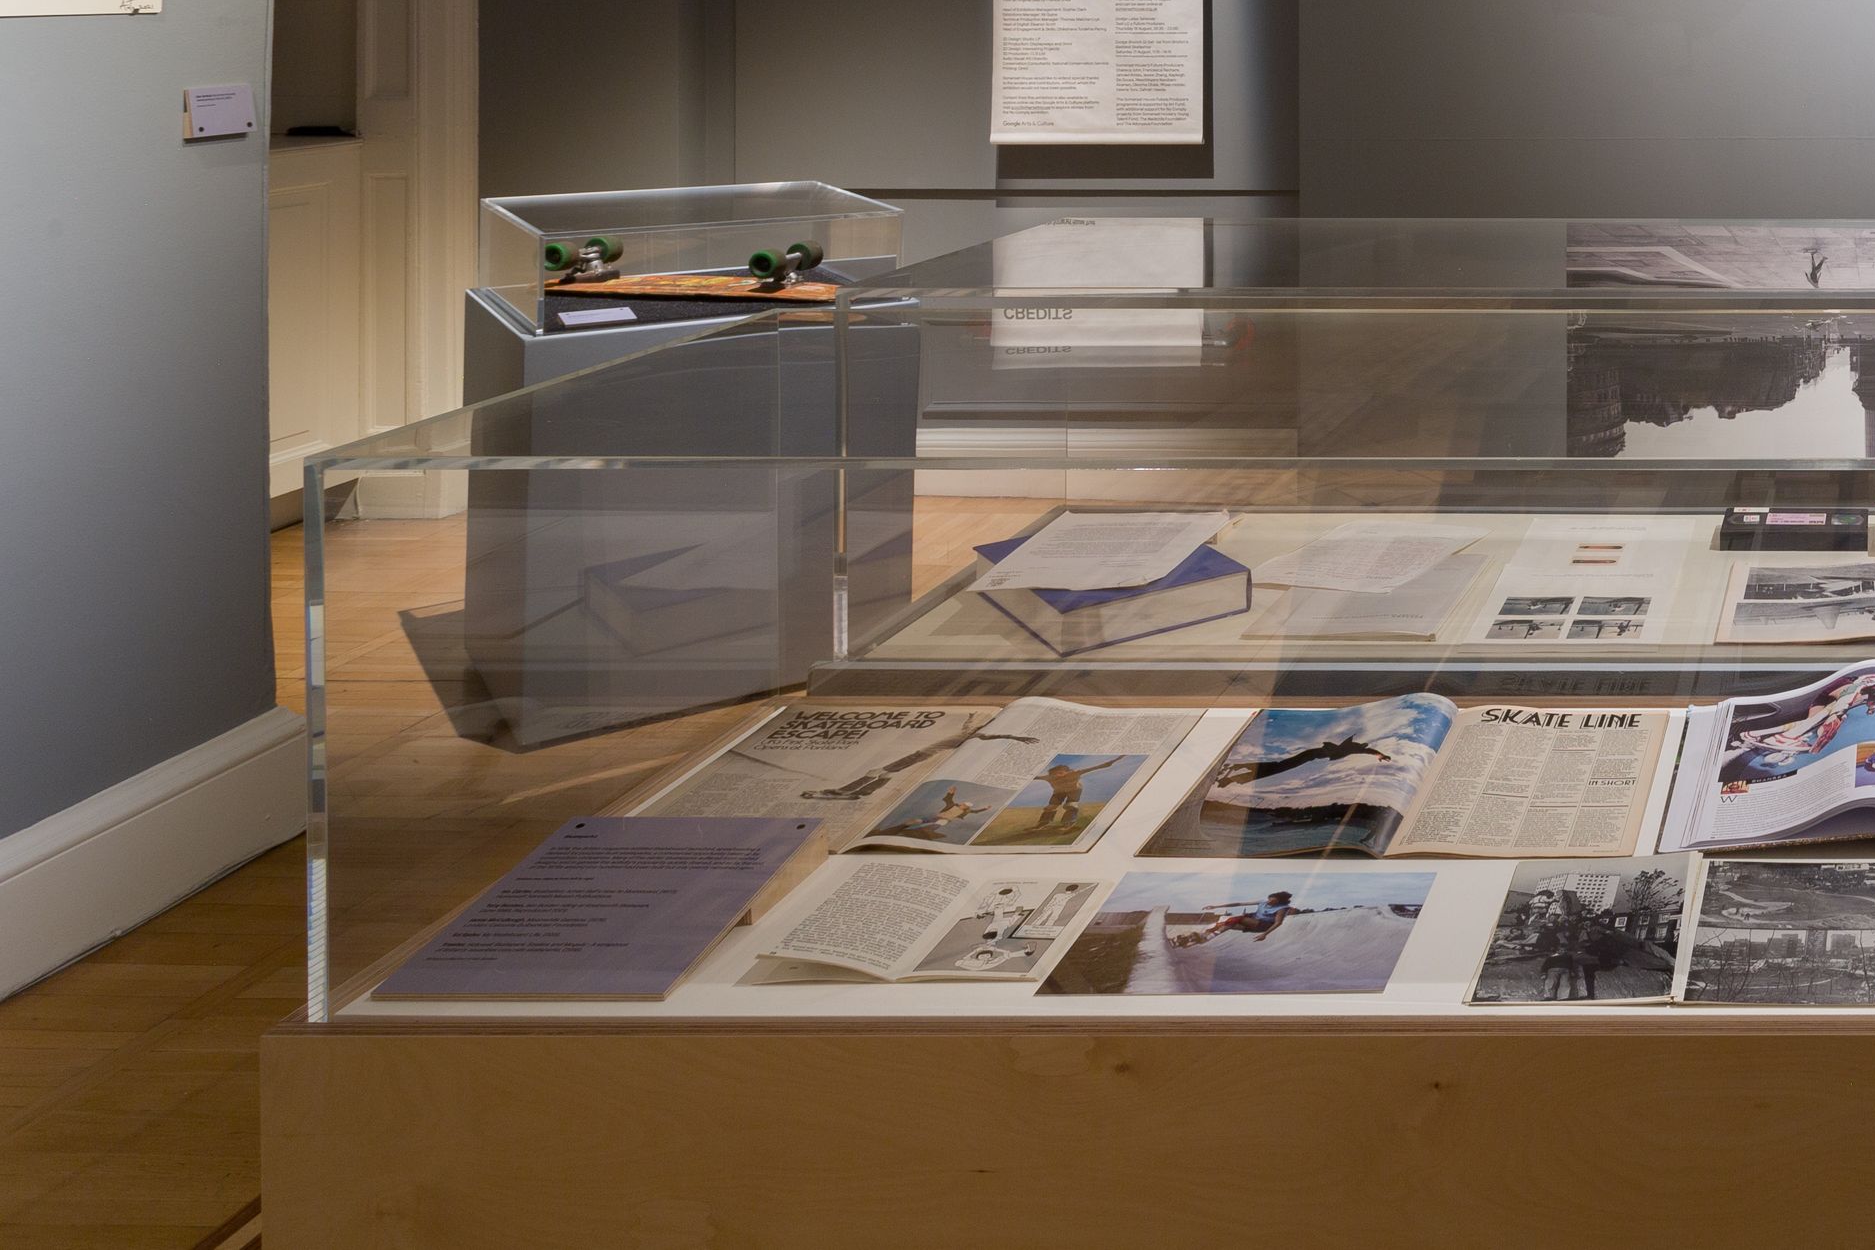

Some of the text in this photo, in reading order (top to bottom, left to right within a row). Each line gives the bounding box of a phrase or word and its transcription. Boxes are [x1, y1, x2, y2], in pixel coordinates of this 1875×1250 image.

[796, 711, 946, 721] WELCOME TO
[1481, 708, 1643, 730] SKATE LINE
[779, 719, 937, 730] SKATEBOARD
[767, 729, 870, 740] ESCAPE!
[1600, 779, 1637, 787] SHORT
